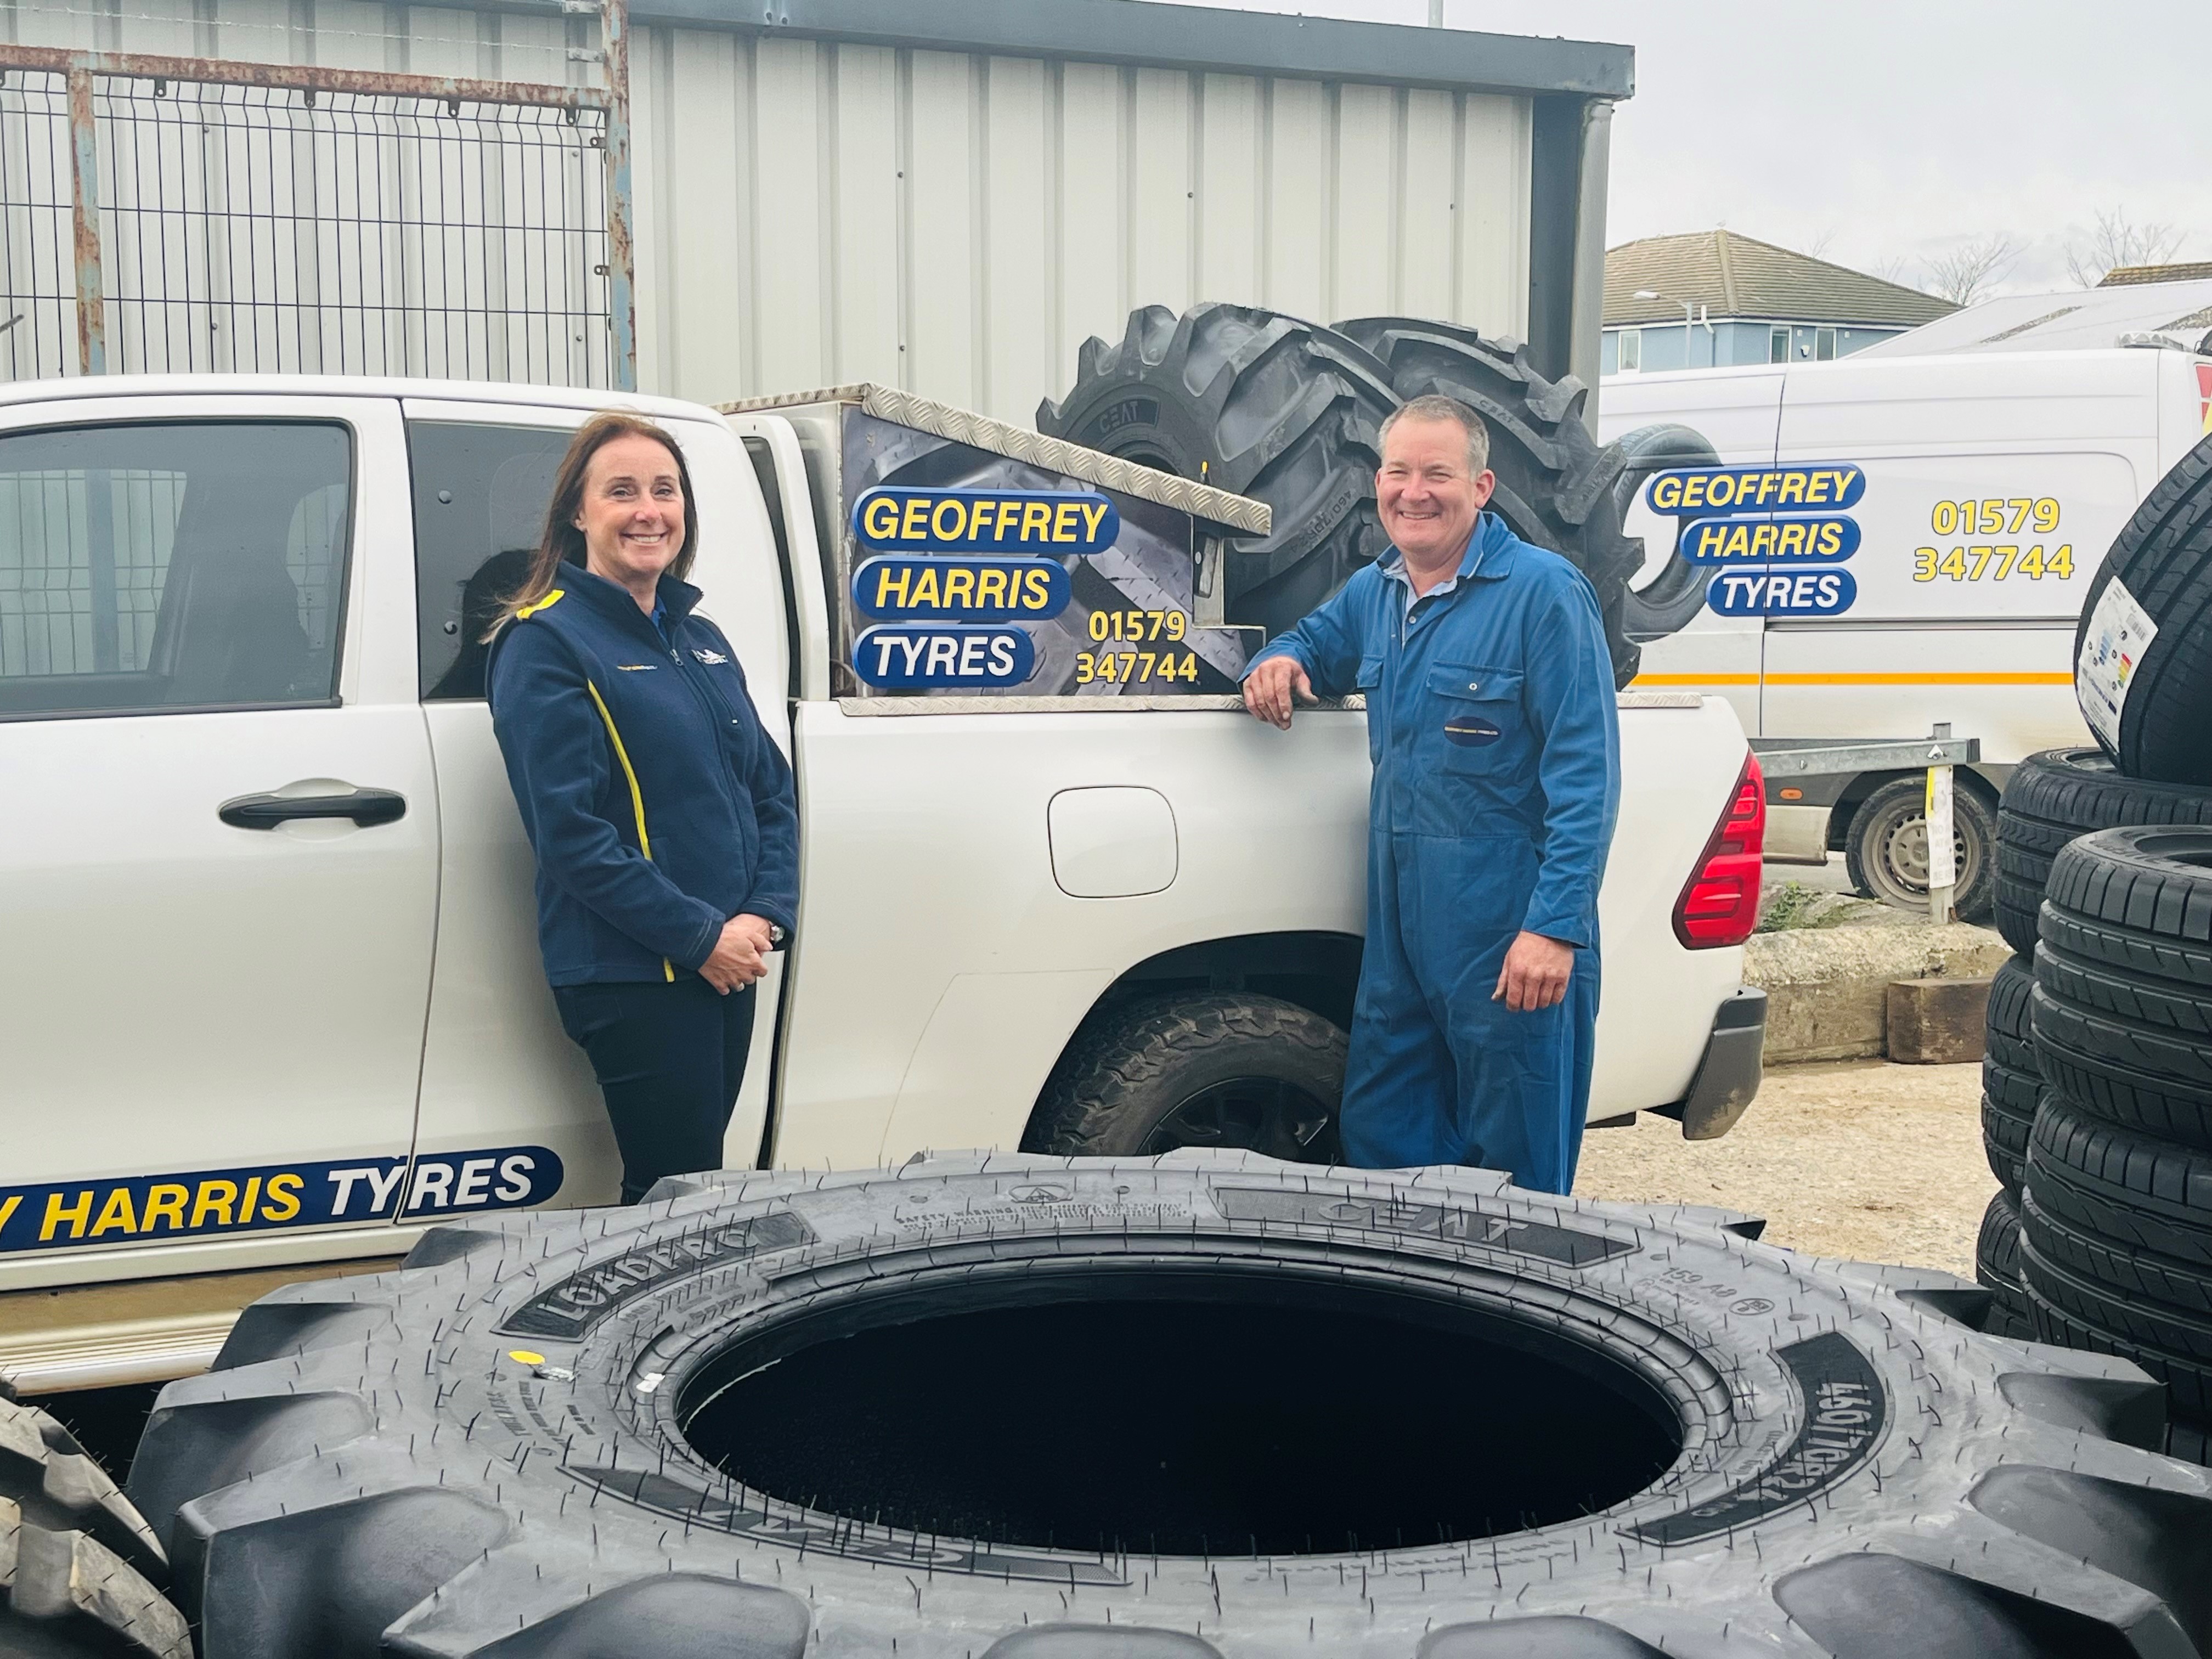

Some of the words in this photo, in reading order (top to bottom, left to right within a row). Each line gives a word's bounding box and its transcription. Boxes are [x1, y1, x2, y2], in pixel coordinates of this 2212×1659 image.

[1099, 401, 1138, 433] CEAT
[1654, 471, 1857, 507] GEOFFREY
[864, 497, 1108, 543] GEOFFREY
[1932, 498, 2061, 535] 01579
[1697, 522, 1843, 557] HARRIS
[1914, 545, 2075, 582] 347744
[876, 567, 1051, 610] HARRIS
[1723, 574, 1841, 608] TYRES
[1088, 610, 1186, 641] 01579
[872, 635, 1017, 676] TYRES
[1076, 652, 1198, 684] 347744
[38, 1173, 305, 1242] HARRIS
[328, 1154, 535, 1216] TYRES
[1318, 1202, 1529, 1242] CEAT
[537, 1228, 759, 1321] LOADPRO
[1662, 1267, 1703, 1284] 159
[1700, 1284, 1737, 1297] A8
